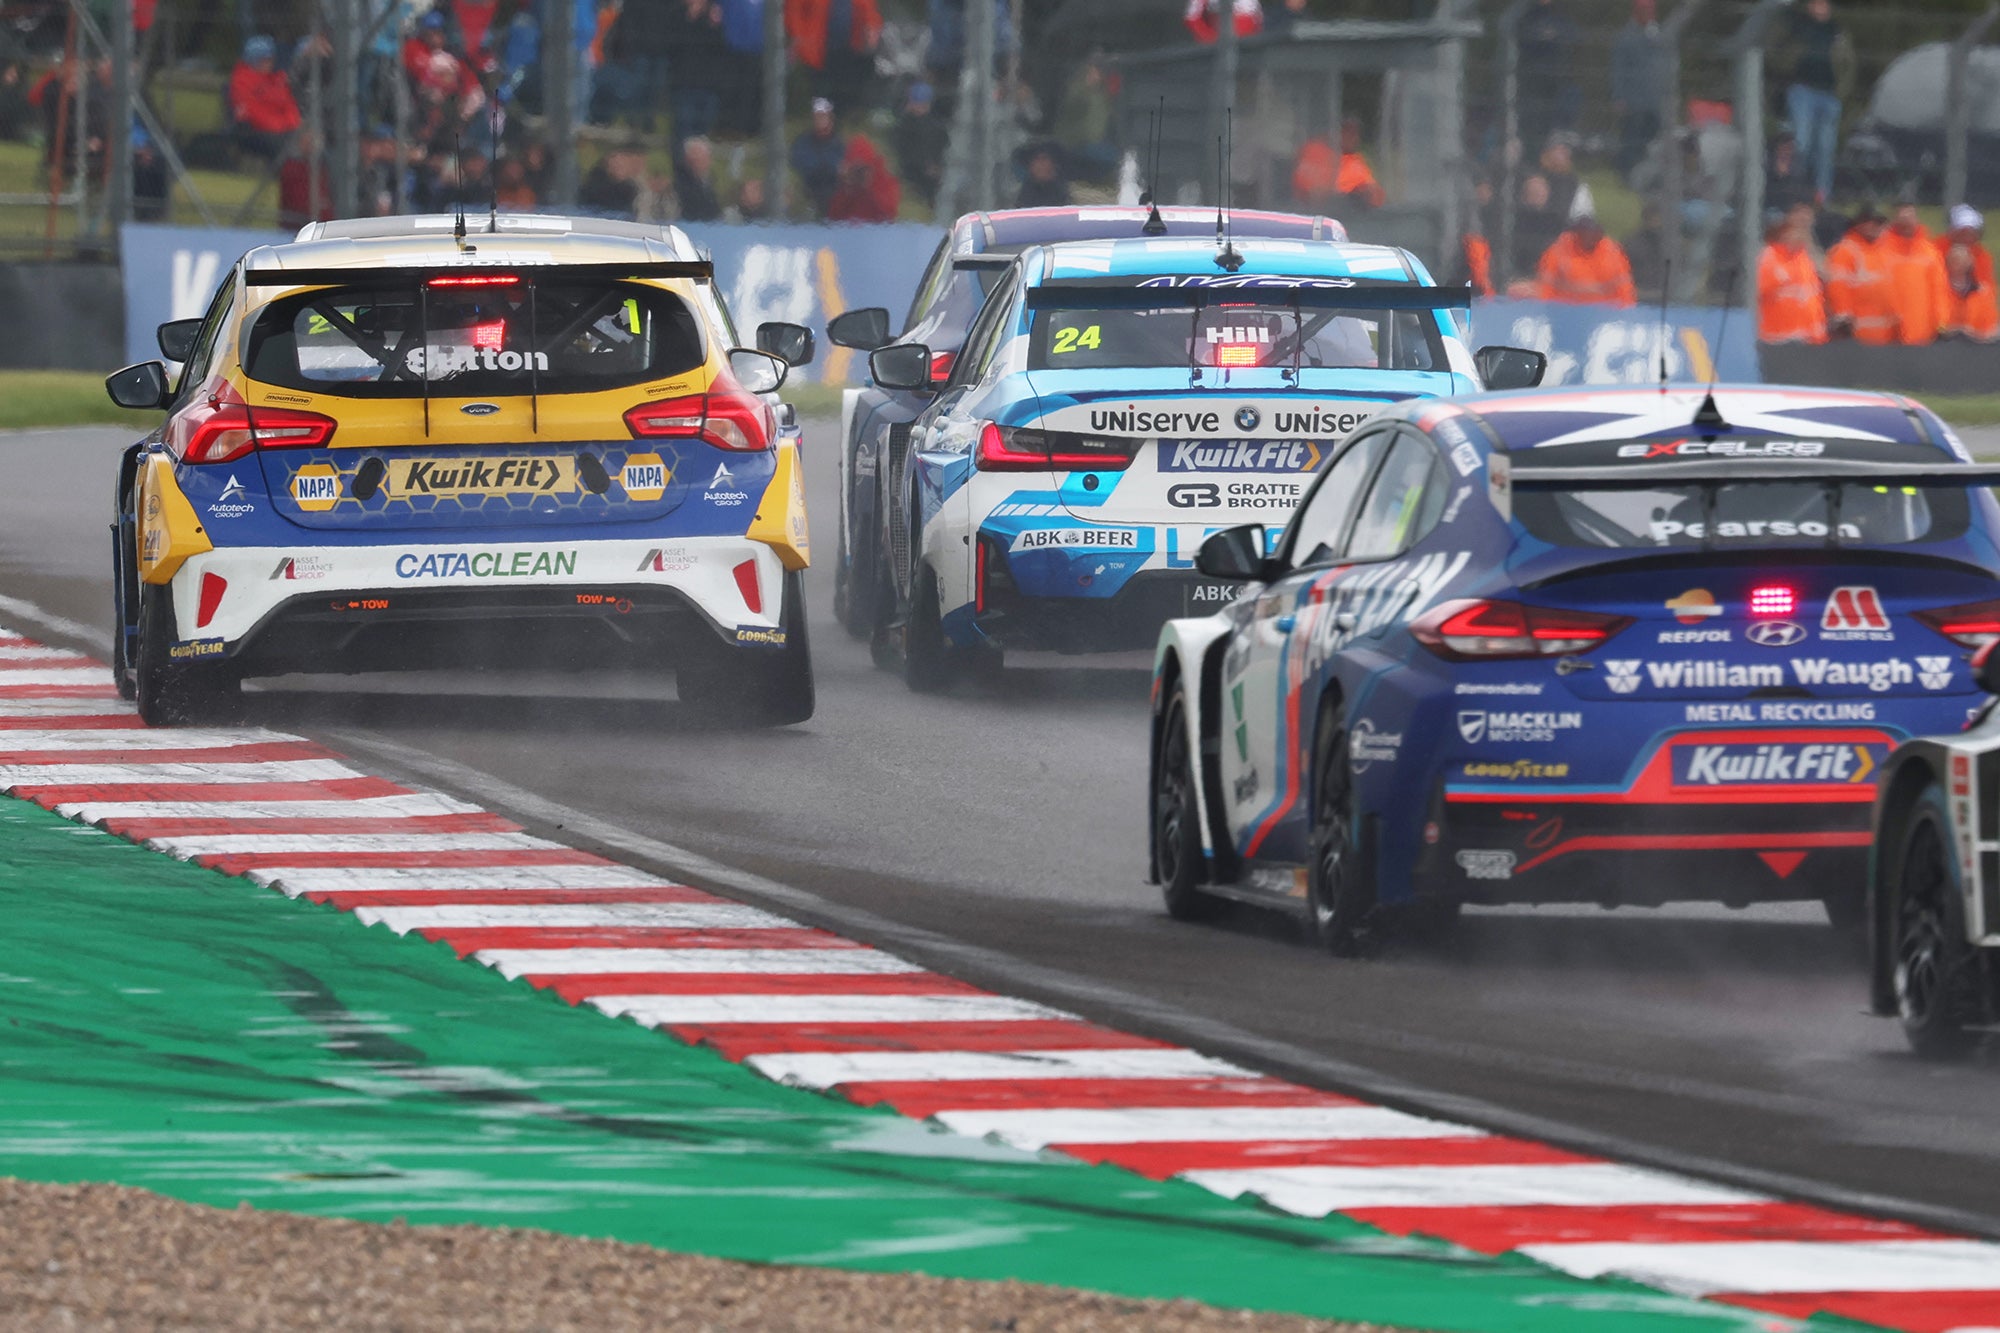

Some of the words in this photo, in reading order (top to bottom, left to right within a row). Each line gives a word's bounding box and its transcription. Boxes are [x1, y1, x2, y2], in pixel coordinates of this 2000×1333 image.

[623, 298, 640, 334] 1
[1052, 325, 1101, 353] 24
[1205, 326, 1269, 344] Hill
[627, 466, 663, 487] NAPA
[298, 477, 336, 498] NAPA
[703, 491, 748, 501] Autotech
[1167, 483, 1222, 508] GB
[1228, 483, 1300, 496] GRATTE
[207, 503, 255, 513] Autotech
[1023, 531, 1062, 547] ABK
[1083, 531, 1134, 546] BEER
[1650, 520, 1862, 541] Pearson
[295, 556, 319, 564] ASSET
[395, 551, 577, 579] CATACLEAN
[1109, 562, 1126, 570] TOW
[576, 594, 603, 604] TOW
[1192, 585, 1234, 601] ABK
[361, 600, 389, 609] TOW
[1658, 630, 1732, 643] REPSOL
[1646, 659, 1784, 688] William
[1790, 657, 1914, 692] Waugh
[1488, 711, 1582, 729] MACKLIN
[1685, 704, 1756, 722] METAL
[1760, 702, 1876, 721] RECYCLING
[1488, 729, 1555, 742] MOTORS
